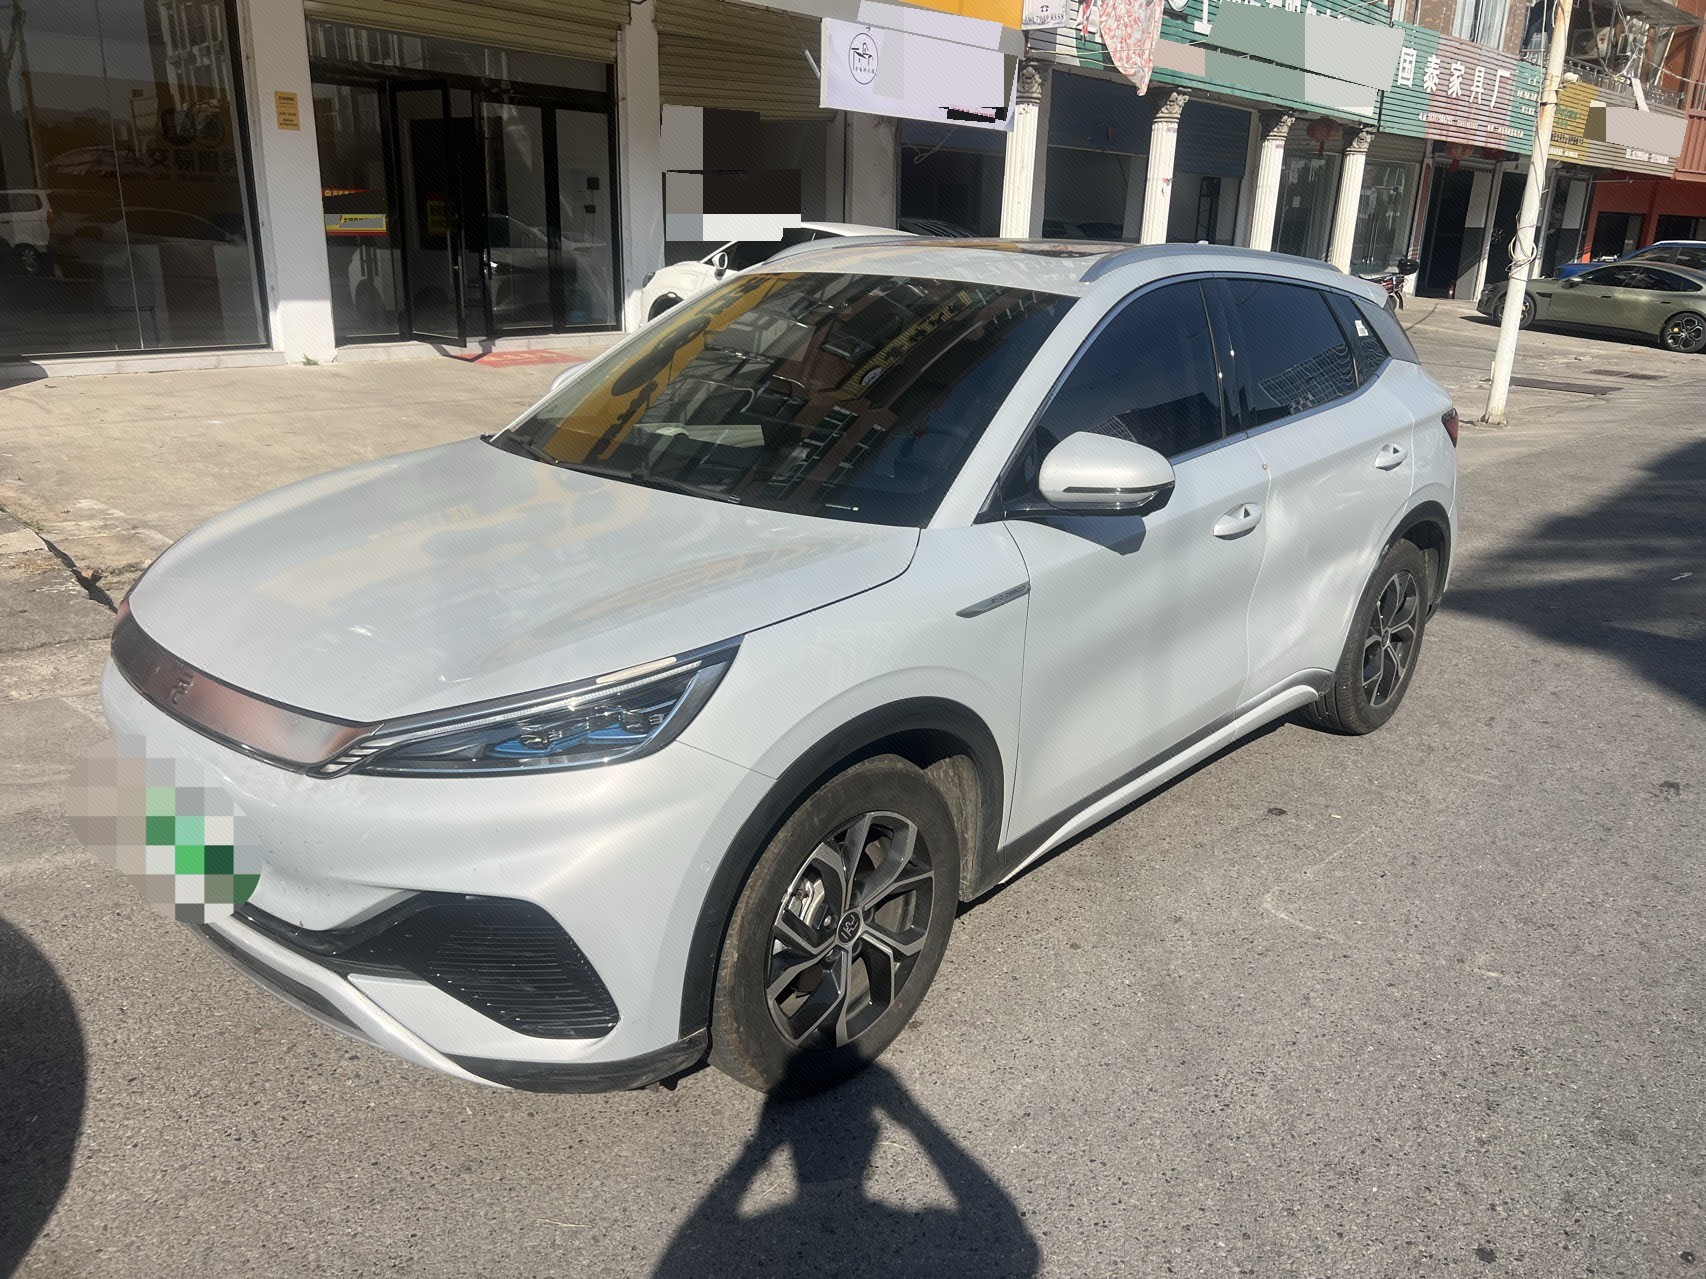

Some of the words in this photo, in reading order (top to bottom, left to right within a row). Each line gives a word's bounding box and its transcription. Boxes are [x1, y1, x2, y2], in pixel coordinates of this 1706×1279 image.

[1397, 46, 1511, 109] 国泰家具厂
